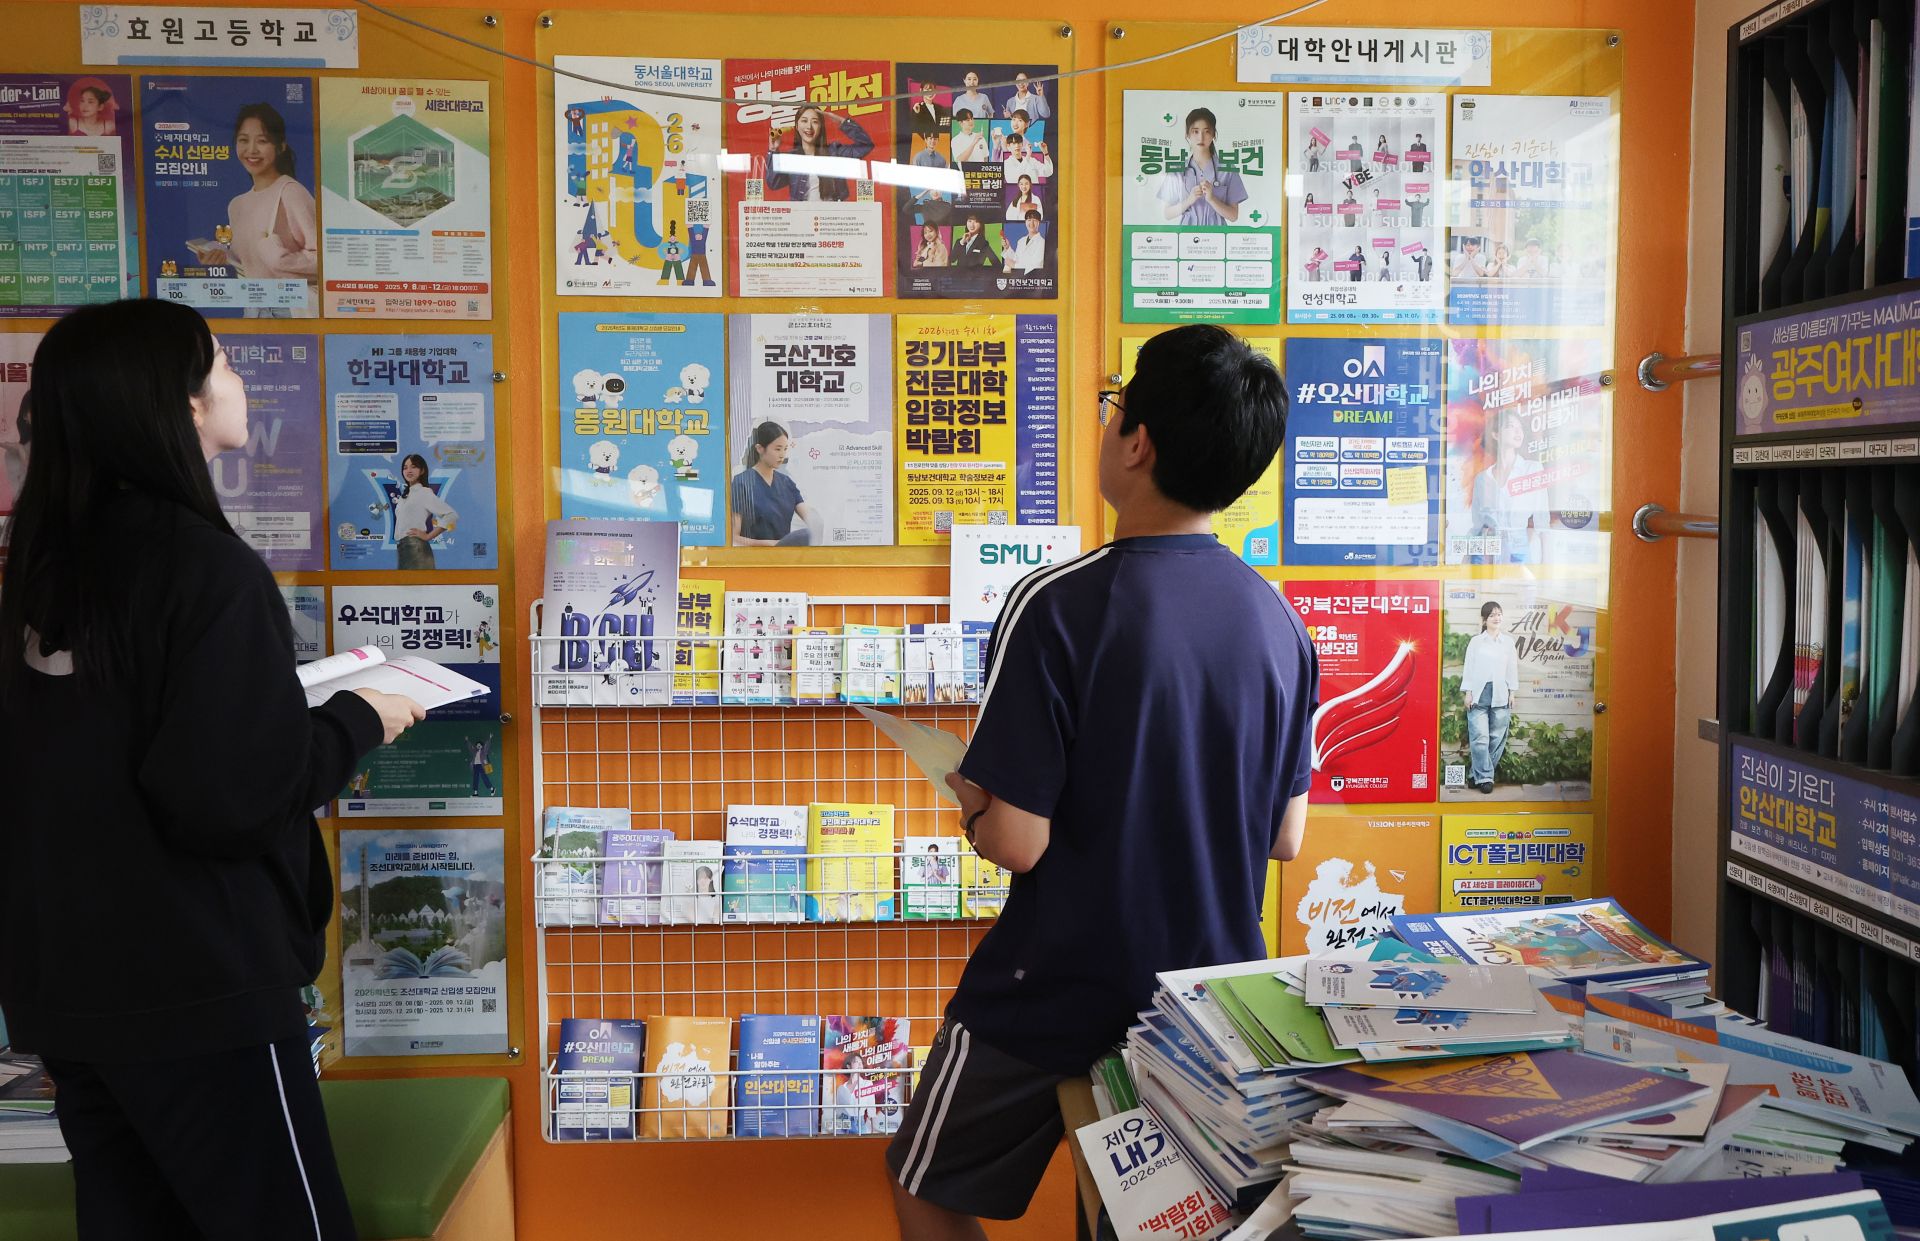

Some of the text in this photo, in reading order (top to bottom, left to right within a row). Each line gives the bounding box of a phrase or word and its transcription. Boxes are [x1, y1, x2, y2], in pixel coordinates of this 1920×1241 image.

[127, 17, 317, 45] 효원고등학교
[1277, 38, 1458, 65] 대학안내게시판
[634, 65, 713, 80] 동서울대학교
[32, 86, 60, 100] Land
[362, 86, 386, 95] 세상에
[388, 87, 396, 95] 내
[425, 100, 484, 112] 세한대학교
[164, 134, 209, 142] 배재대학교
[155, 145, 230, 160] 수시 신입생
[1139, 144, 1264, 176] 동남 보건
[1465, 143, 1504, 159] 진심이
[155, 163, 208, 175] 모집안내
[1342, 168, 1374, 191] VIBE
[1469, 161, 1593, 189] 안산대학교
[414, 299, 456, 307] 1899-0180
[1302, 293, 1358, 305] 연성대학교
[1772, 325, 1800, 344] 세상을
[1800, 315, 1838, 339] 아름답게
[1840, 310, 1871, 332] 가꾸는
[765, 344, 856, 367] 군산간호
[905, 341, 1006, 368] 경기남부
[1770, 328, 1920, 401] 광주여자대
[347, 359, 470, 385] 한라대학교
[776, 370, 844, 393] 대학교
[905, 370, 1008, 396] 전문대학
[1469, 374, 1499, 395] 나의
[1297, 382, 1430, 406] #오산대학교
[1483, 381, 1533, 410] 새롭게
[905, 399, 1007, 425] 입학정보
[1332, 410, 1393, 424] DREAM!
[1517, 396, 1548, 418] 나의
[573, 408, 710, 435] 동원대학교
[1531, 405, 1579, 433] 이롭게
[906, 429, 981, 454] 박람회
[1819, 446, 1836, 458] 단국대
[1869, 444, 1887, 455] 대구대
[907, 474, 957, 482] 동남보건대학교
[959, 473, 994, 482] 학술정보관
[965, 488, 980, 496] 13시
[988, 488, 1004, 496] 18시
[965, 497, 980, 505] 10시
[338, 605, 460, 625] 우석대학교가
[1293, 595, 1430, 615] 경북전문대학교
[1509, 611, 1545, 633] All
[401, 629, 472, 650] 경쟁력!
[1338, 633, 1358, 641] 학년도
[1515, 633, 1565, 660] New
[1531, 649, 1566, 662] Again
[1741, 754, 1836, 809] 진심이 키운다
[1739, 784, 1837, 849] 안산대학교
[1863, 798, 1918, 825] 수시 1차 원서접수
[612, 834, 659, 843] 광주여자대학교
[758, 828, 793, 839] 경쟁력!
[1862, 818, 1916, 846] 수시 2차 원서접수
[1449, 843, 1586, 864] ICT폴리텍대학
[1861, 838, 1890, 858] 입학상담
[370, 862, 475, 872] 조선대학교에서 시작됩니다.
[1862, 858, 1890, 879] 홈페이지
[1813, 901, 1830, 918] 숭실대
[1836, 911, 1853, 928] 신라대
[1861, 922, 1879, 940] 안산대
[400, 987, 496, 996] 조선대학교 신입생 모집안내
[835, 1033, 851, 1046] 나의
[582, 1056, 615, 1064] DREAM!
